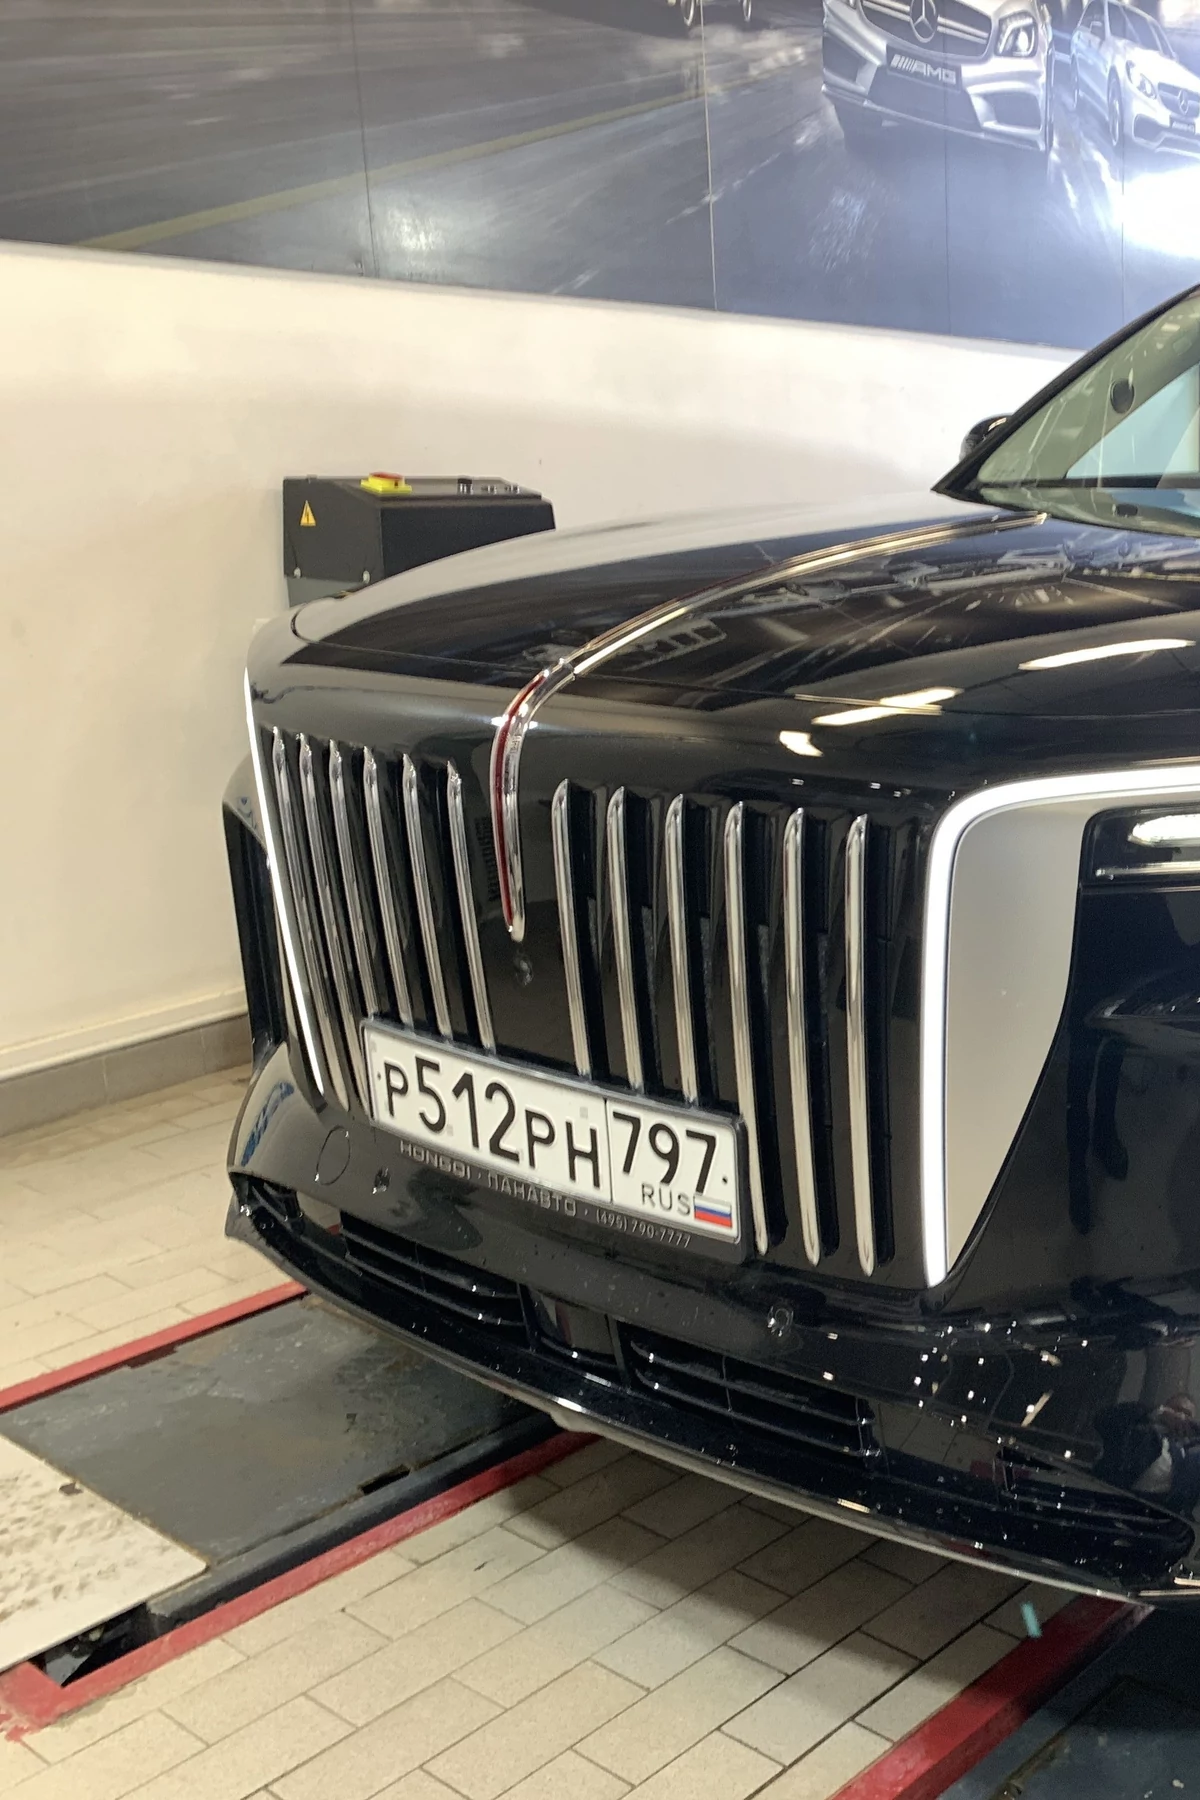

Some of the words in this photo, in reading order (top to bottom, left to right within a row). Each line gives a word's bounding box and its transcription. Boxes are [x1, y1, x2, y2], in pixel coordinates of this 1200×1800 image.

[400, 1139, 471, 1180] HONGQI
[488, 1170, 576, 1217] ПАНАВТО
[596, 1207, 628, 1232] (495)
[631, 1220, 691, 1248] 790-7777
[612, 1111, 716, 1195] 797
[641, 1183, 691, 1216] RUS
